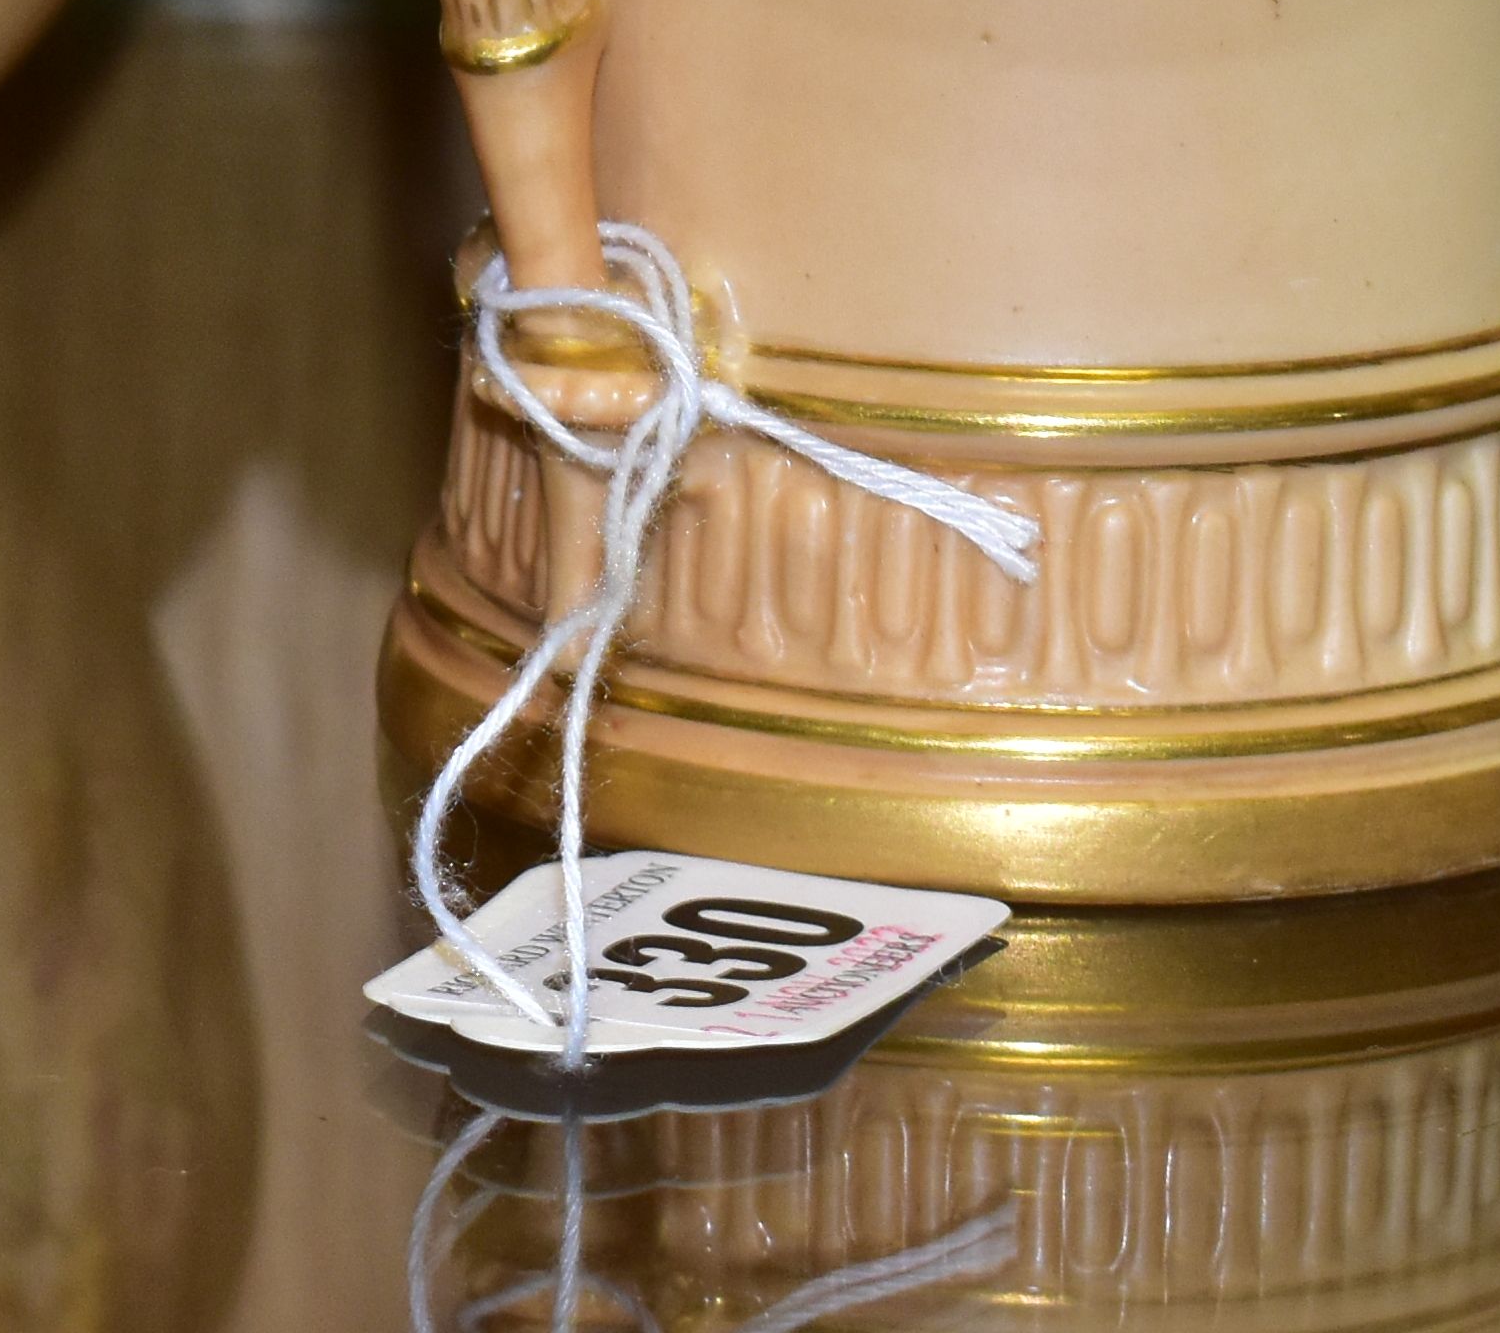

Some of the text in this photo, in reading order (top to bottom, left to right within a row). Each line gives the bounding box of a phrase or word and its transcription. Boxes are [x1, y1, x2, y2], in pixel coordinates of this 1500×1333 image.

[427, 862, 682, 996] RICRD WTERTON
[543, 897, 865, 1008] 330
[771, 932, 937, 1015] AUCTIONEERS
